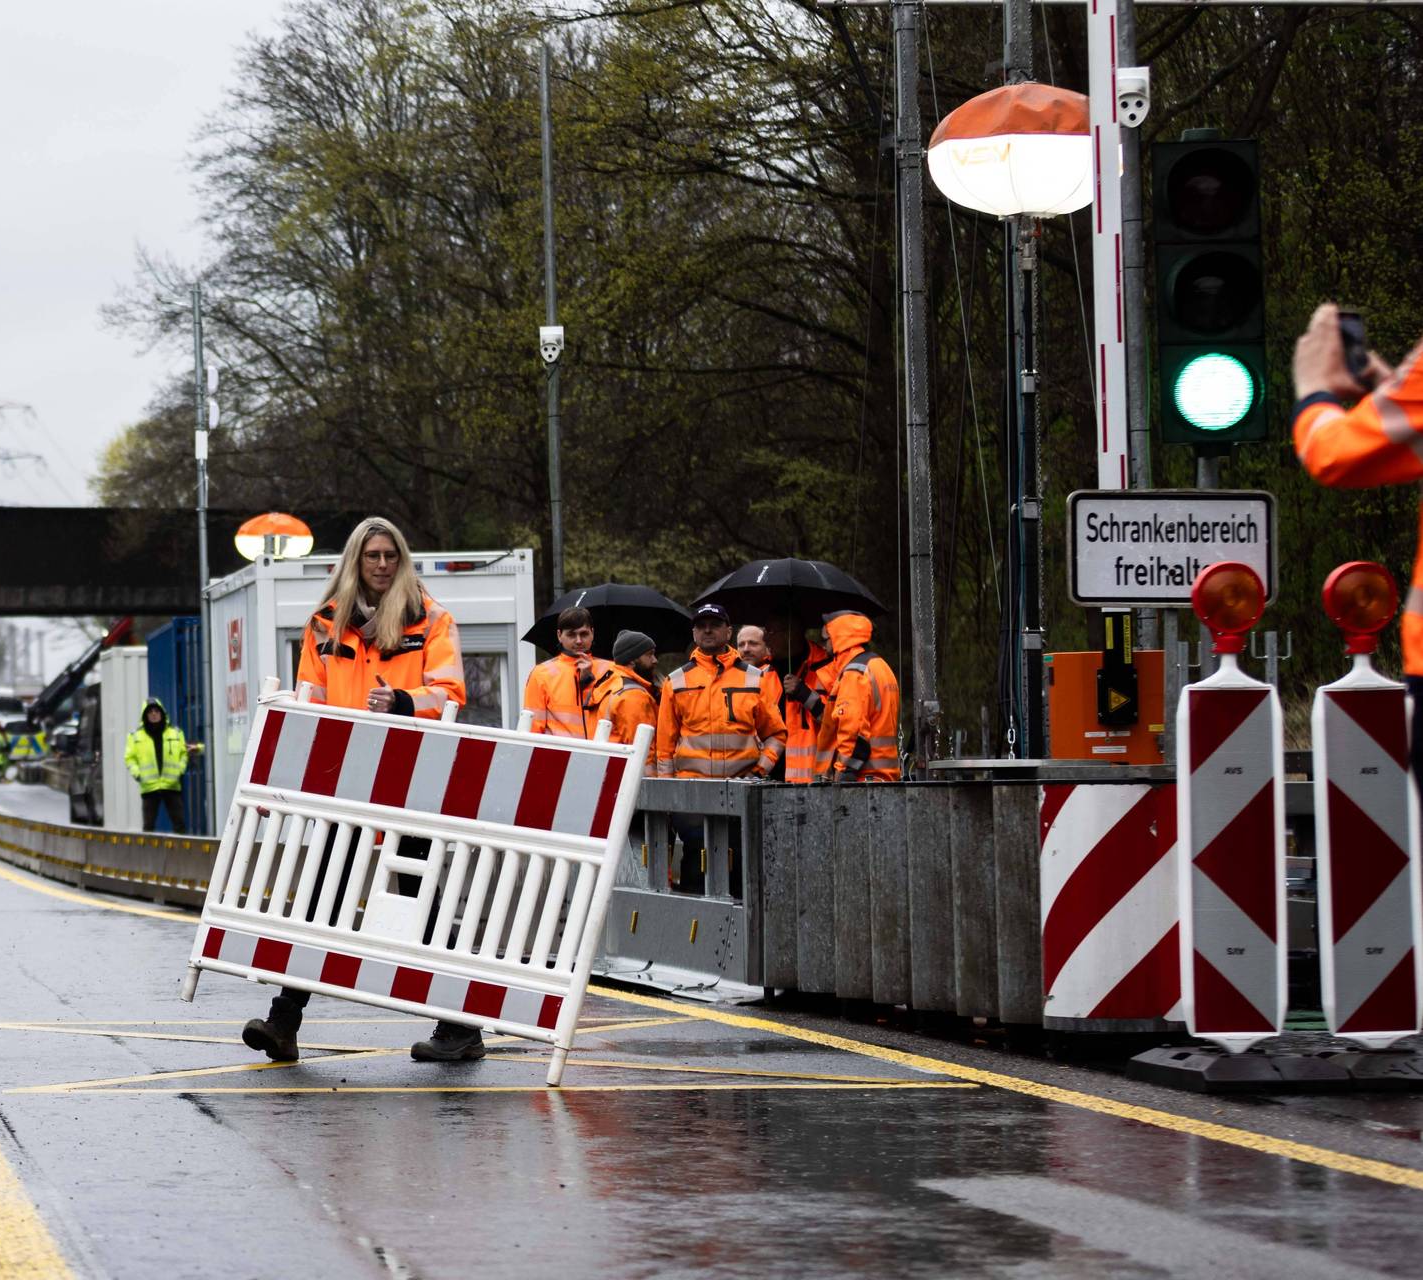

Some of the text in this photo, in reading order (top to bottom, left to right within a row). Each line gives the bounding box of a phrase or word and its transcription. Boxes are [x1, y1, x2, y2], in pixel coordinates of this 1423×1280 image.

[1085, 511, 1259, 544] Schrankenbereich
[1114, 555, 1211, 587] freihalt
[1223, 767, 1243, 775] AVS
[1360, 766, 1379, 775] AVS
